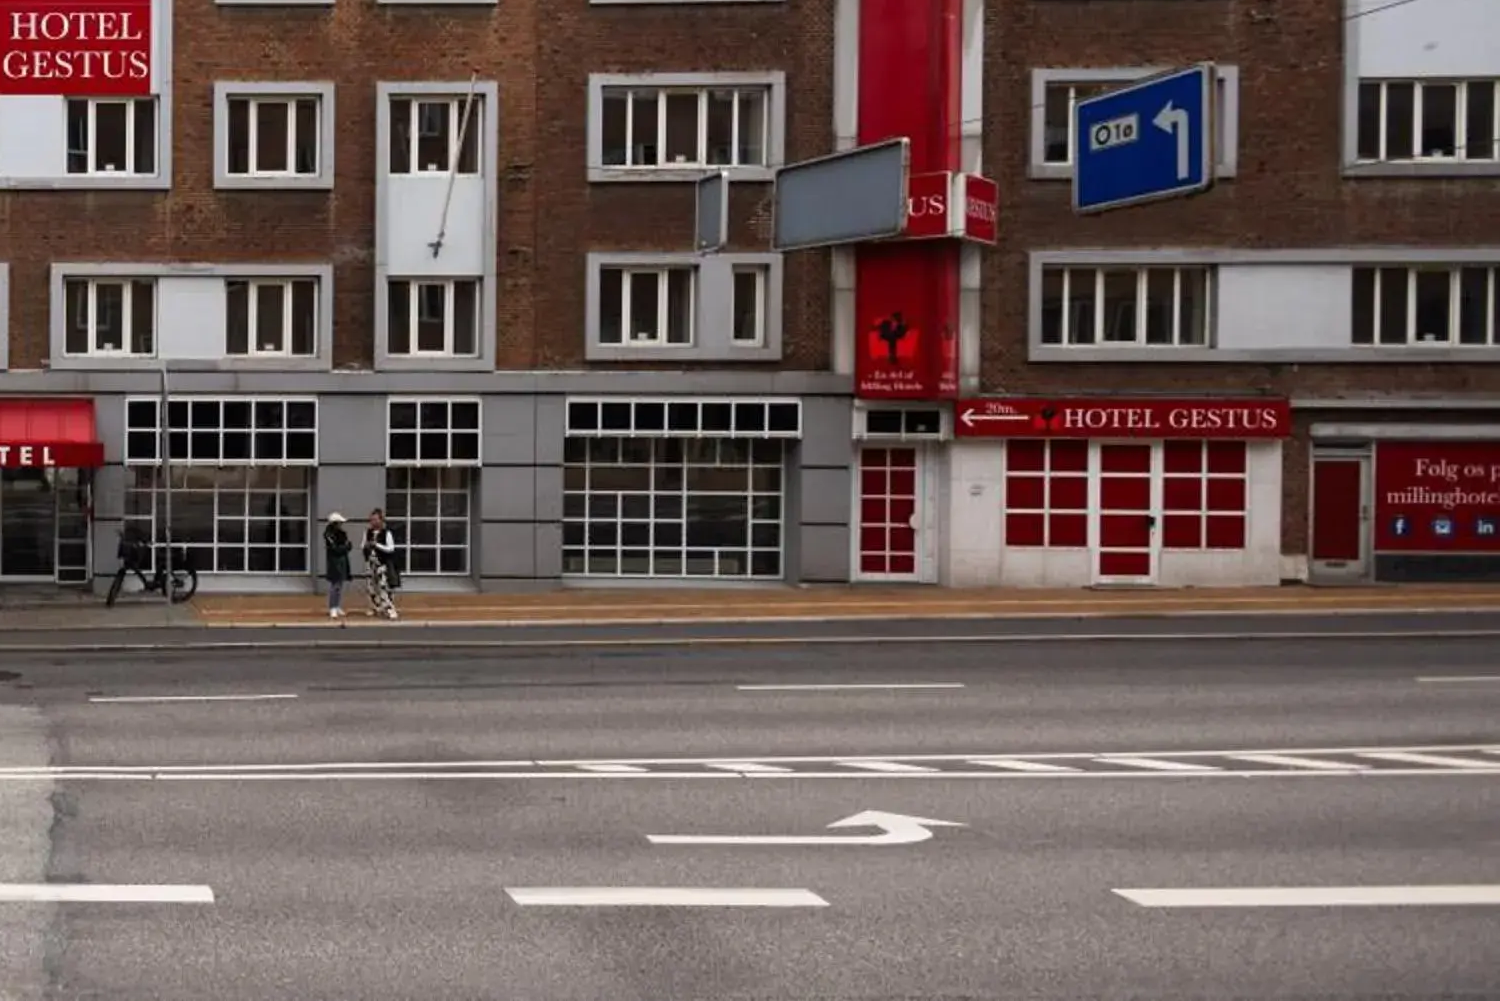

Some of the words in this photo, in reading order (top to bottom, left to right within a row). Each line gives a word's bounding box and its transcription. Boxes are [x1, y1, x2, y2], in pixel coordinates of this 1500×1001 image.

[10, 12, 142, 40] HOTEL
[3, 50, 149, 78] GESTUS
[1064, 408, 1161, 428] HOTEL
[1169, 408, 1277, 429] GESTUS
[1463, 465, 1485, 477] os
